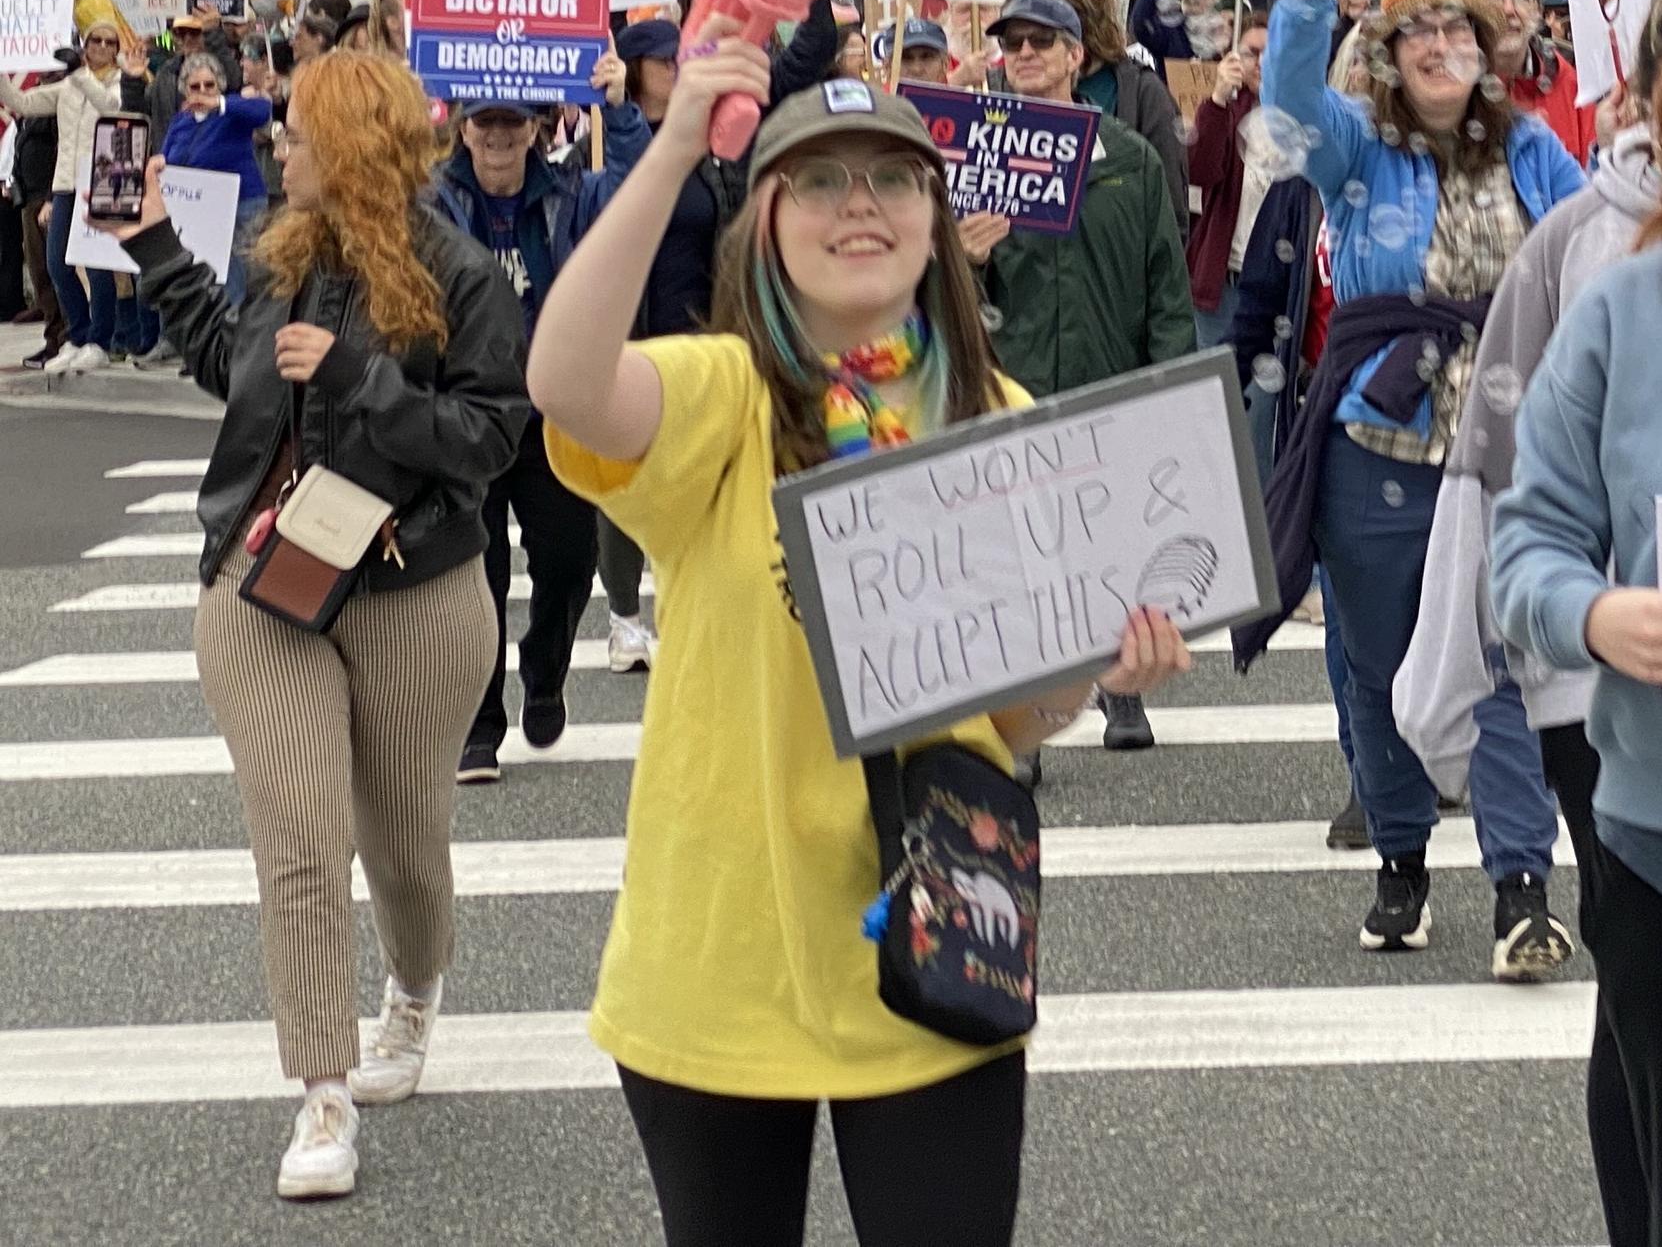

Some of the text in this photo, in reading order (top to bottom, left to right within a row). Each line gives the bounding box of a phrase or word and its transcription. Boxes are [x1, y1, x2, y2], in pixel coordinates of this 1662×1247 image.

[495, 18, 527, 44] OR
[437, 40, 582, 75] DEMOCRACY
[449, 82, 565, 102] THAT'S THE CHOICE
[922, 113, 1078, 163] O KINGS
[976, 149, 1000, 169] IN
[944, 162, 1066, 207] ERICA
[948, 191, 980, 211] INCE
[817, 413, 1115, 544] WE WON'T
[847, 523, 974, 619] ROLL
[1024, 480, 1112, 557] UP
[1142, 456, 1190, 528] &
[860, 564, 1140, 720] ACCEPT THIS
